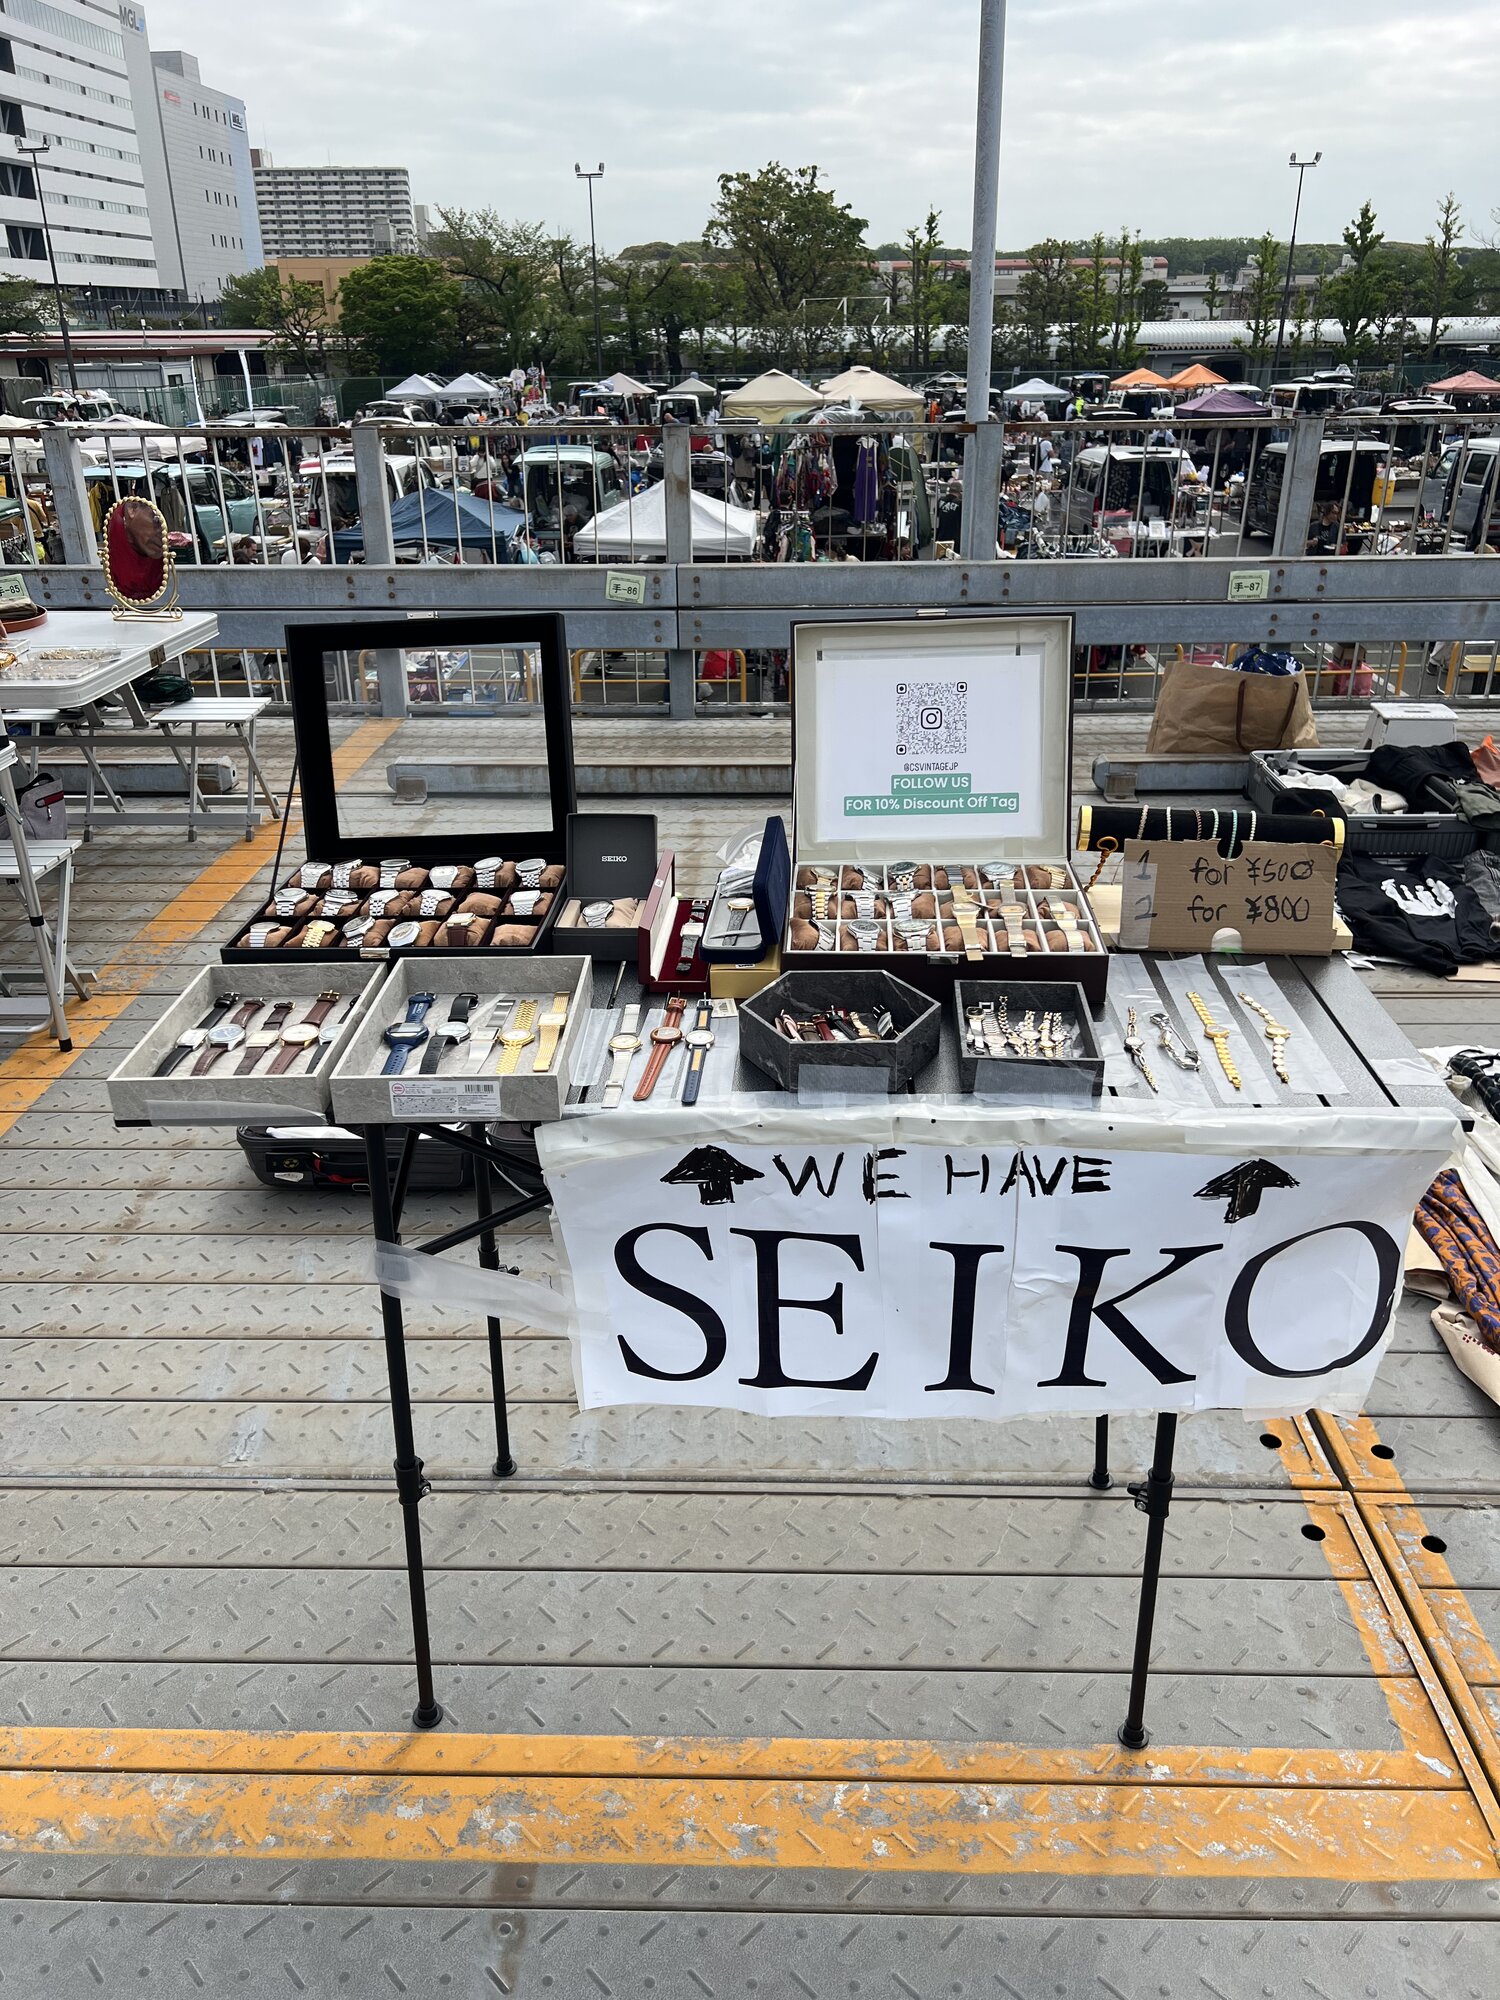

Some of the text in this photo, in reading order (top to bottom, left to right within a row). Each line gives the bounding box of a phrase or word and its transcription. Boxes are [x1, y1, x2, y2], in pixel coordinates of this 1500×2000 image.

[903, 762, 959, 772] @CSVINTAGEJP
[893, 776, 969, 789] FOLLOW US
[845, 796, 1017, 811] FOR 10% Discount Off Tag
[601, 855, 628, 863] SEIKO
[1133, 849, 1315, 886] 1 for ¥500
[1134, 894, 1310, 924] 2 for ¥800
[773, 1147, 1112, 1205] WE HAVE
[614, 1219, 1401, 1395] SEIKO
